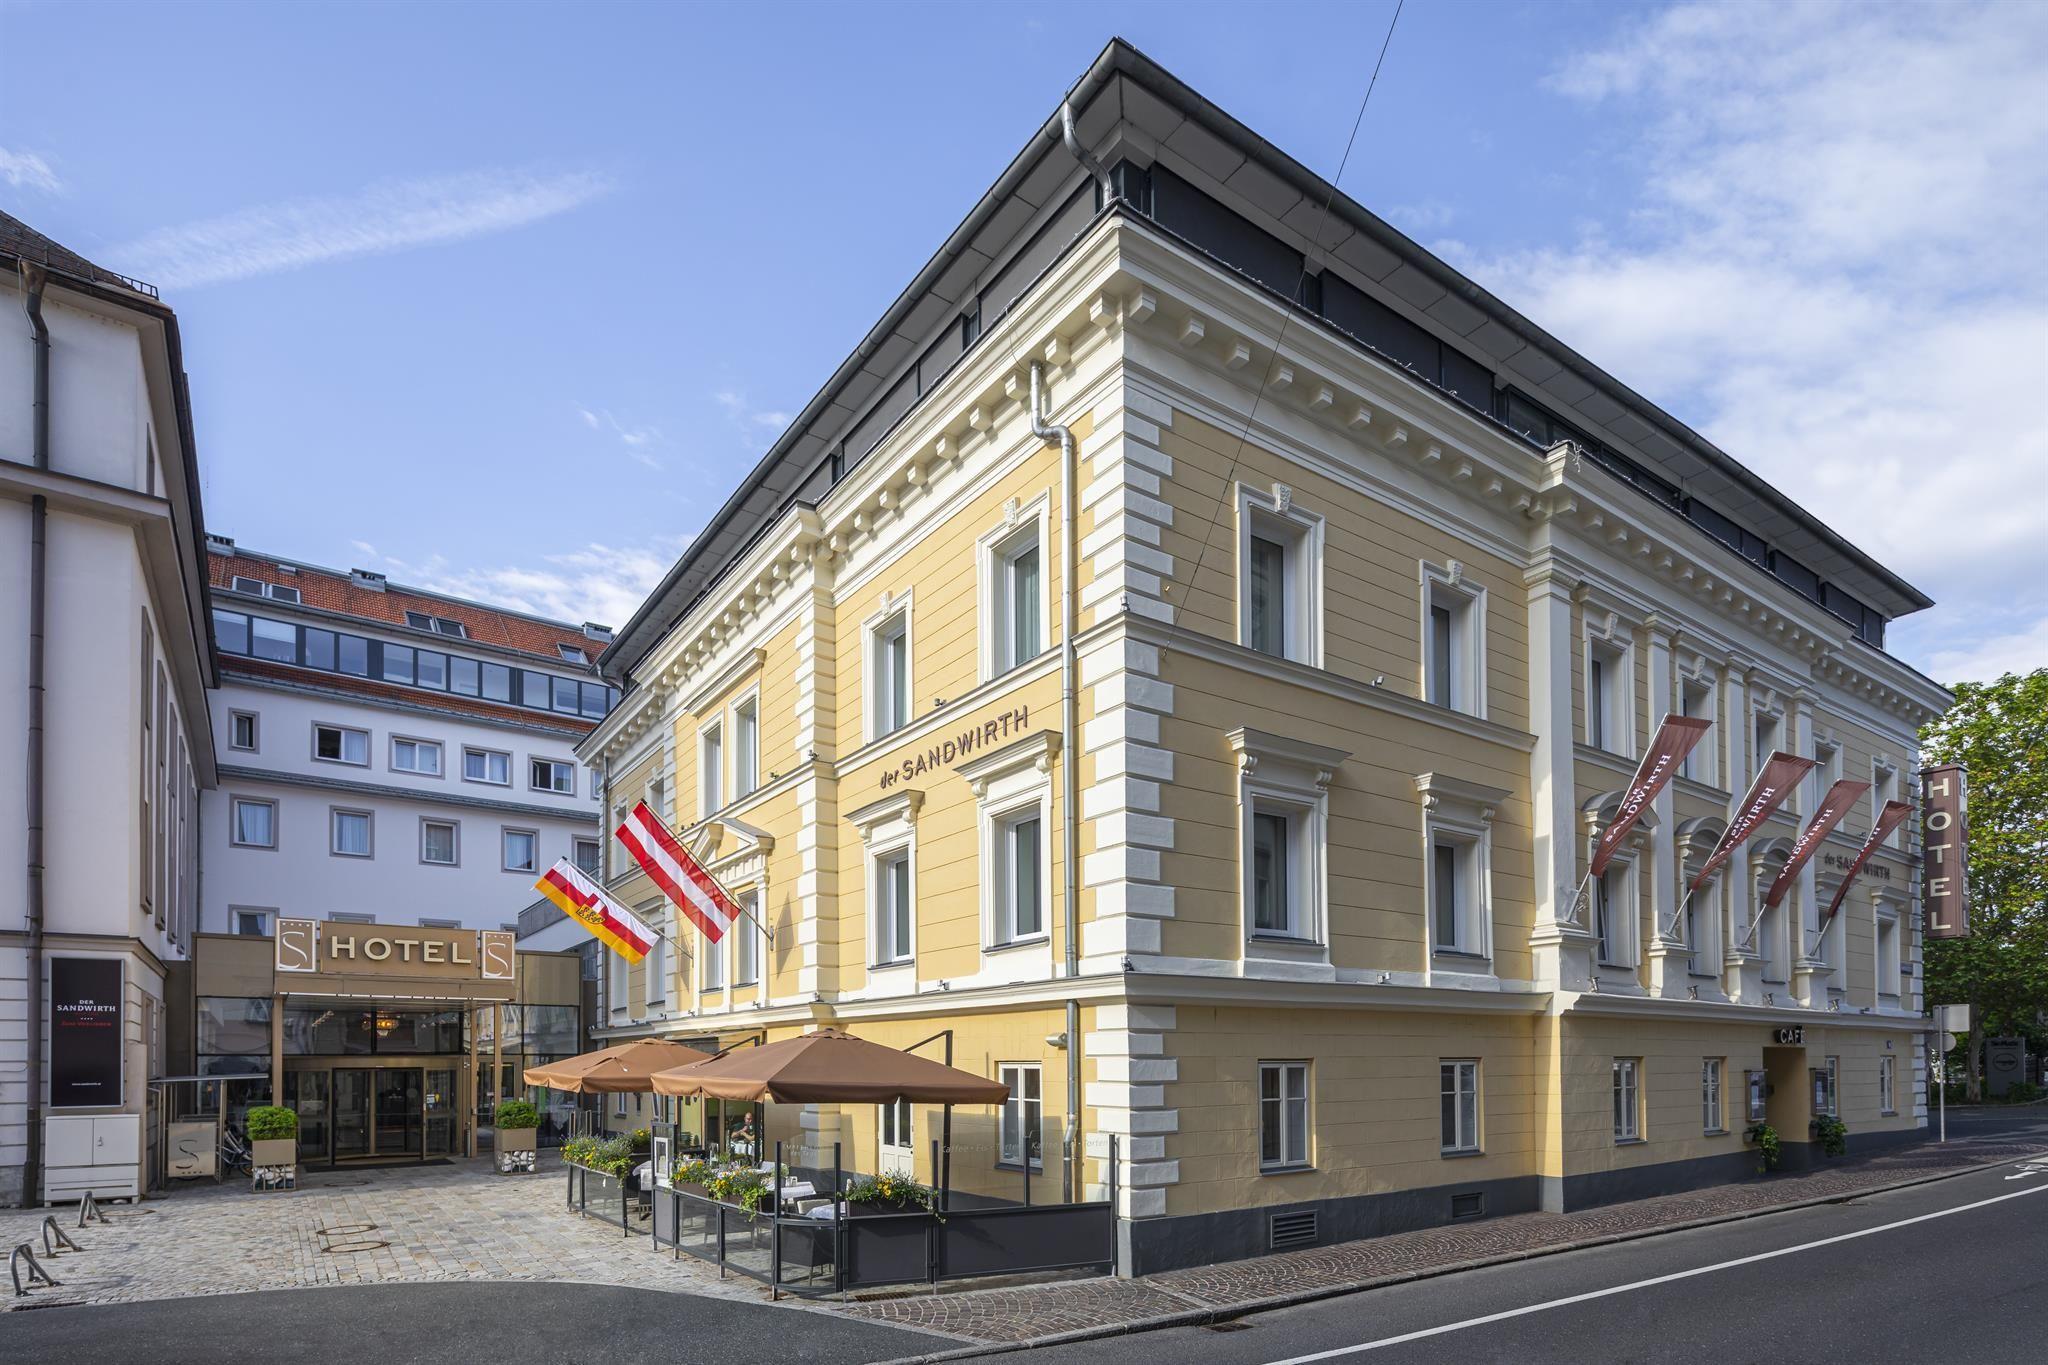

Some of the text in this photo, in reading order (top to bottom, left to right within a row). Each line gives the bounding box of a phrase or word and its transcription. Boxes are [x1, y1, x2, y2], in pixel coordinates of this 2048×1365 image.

[880, 704, 1028, 790] der SANDWIRTH
[1926, 777, 1952, 930] HOTEL
[331, 935, 473, 965] HOTEL
[56, 1004, 116, 1013] SANDWIRTH
